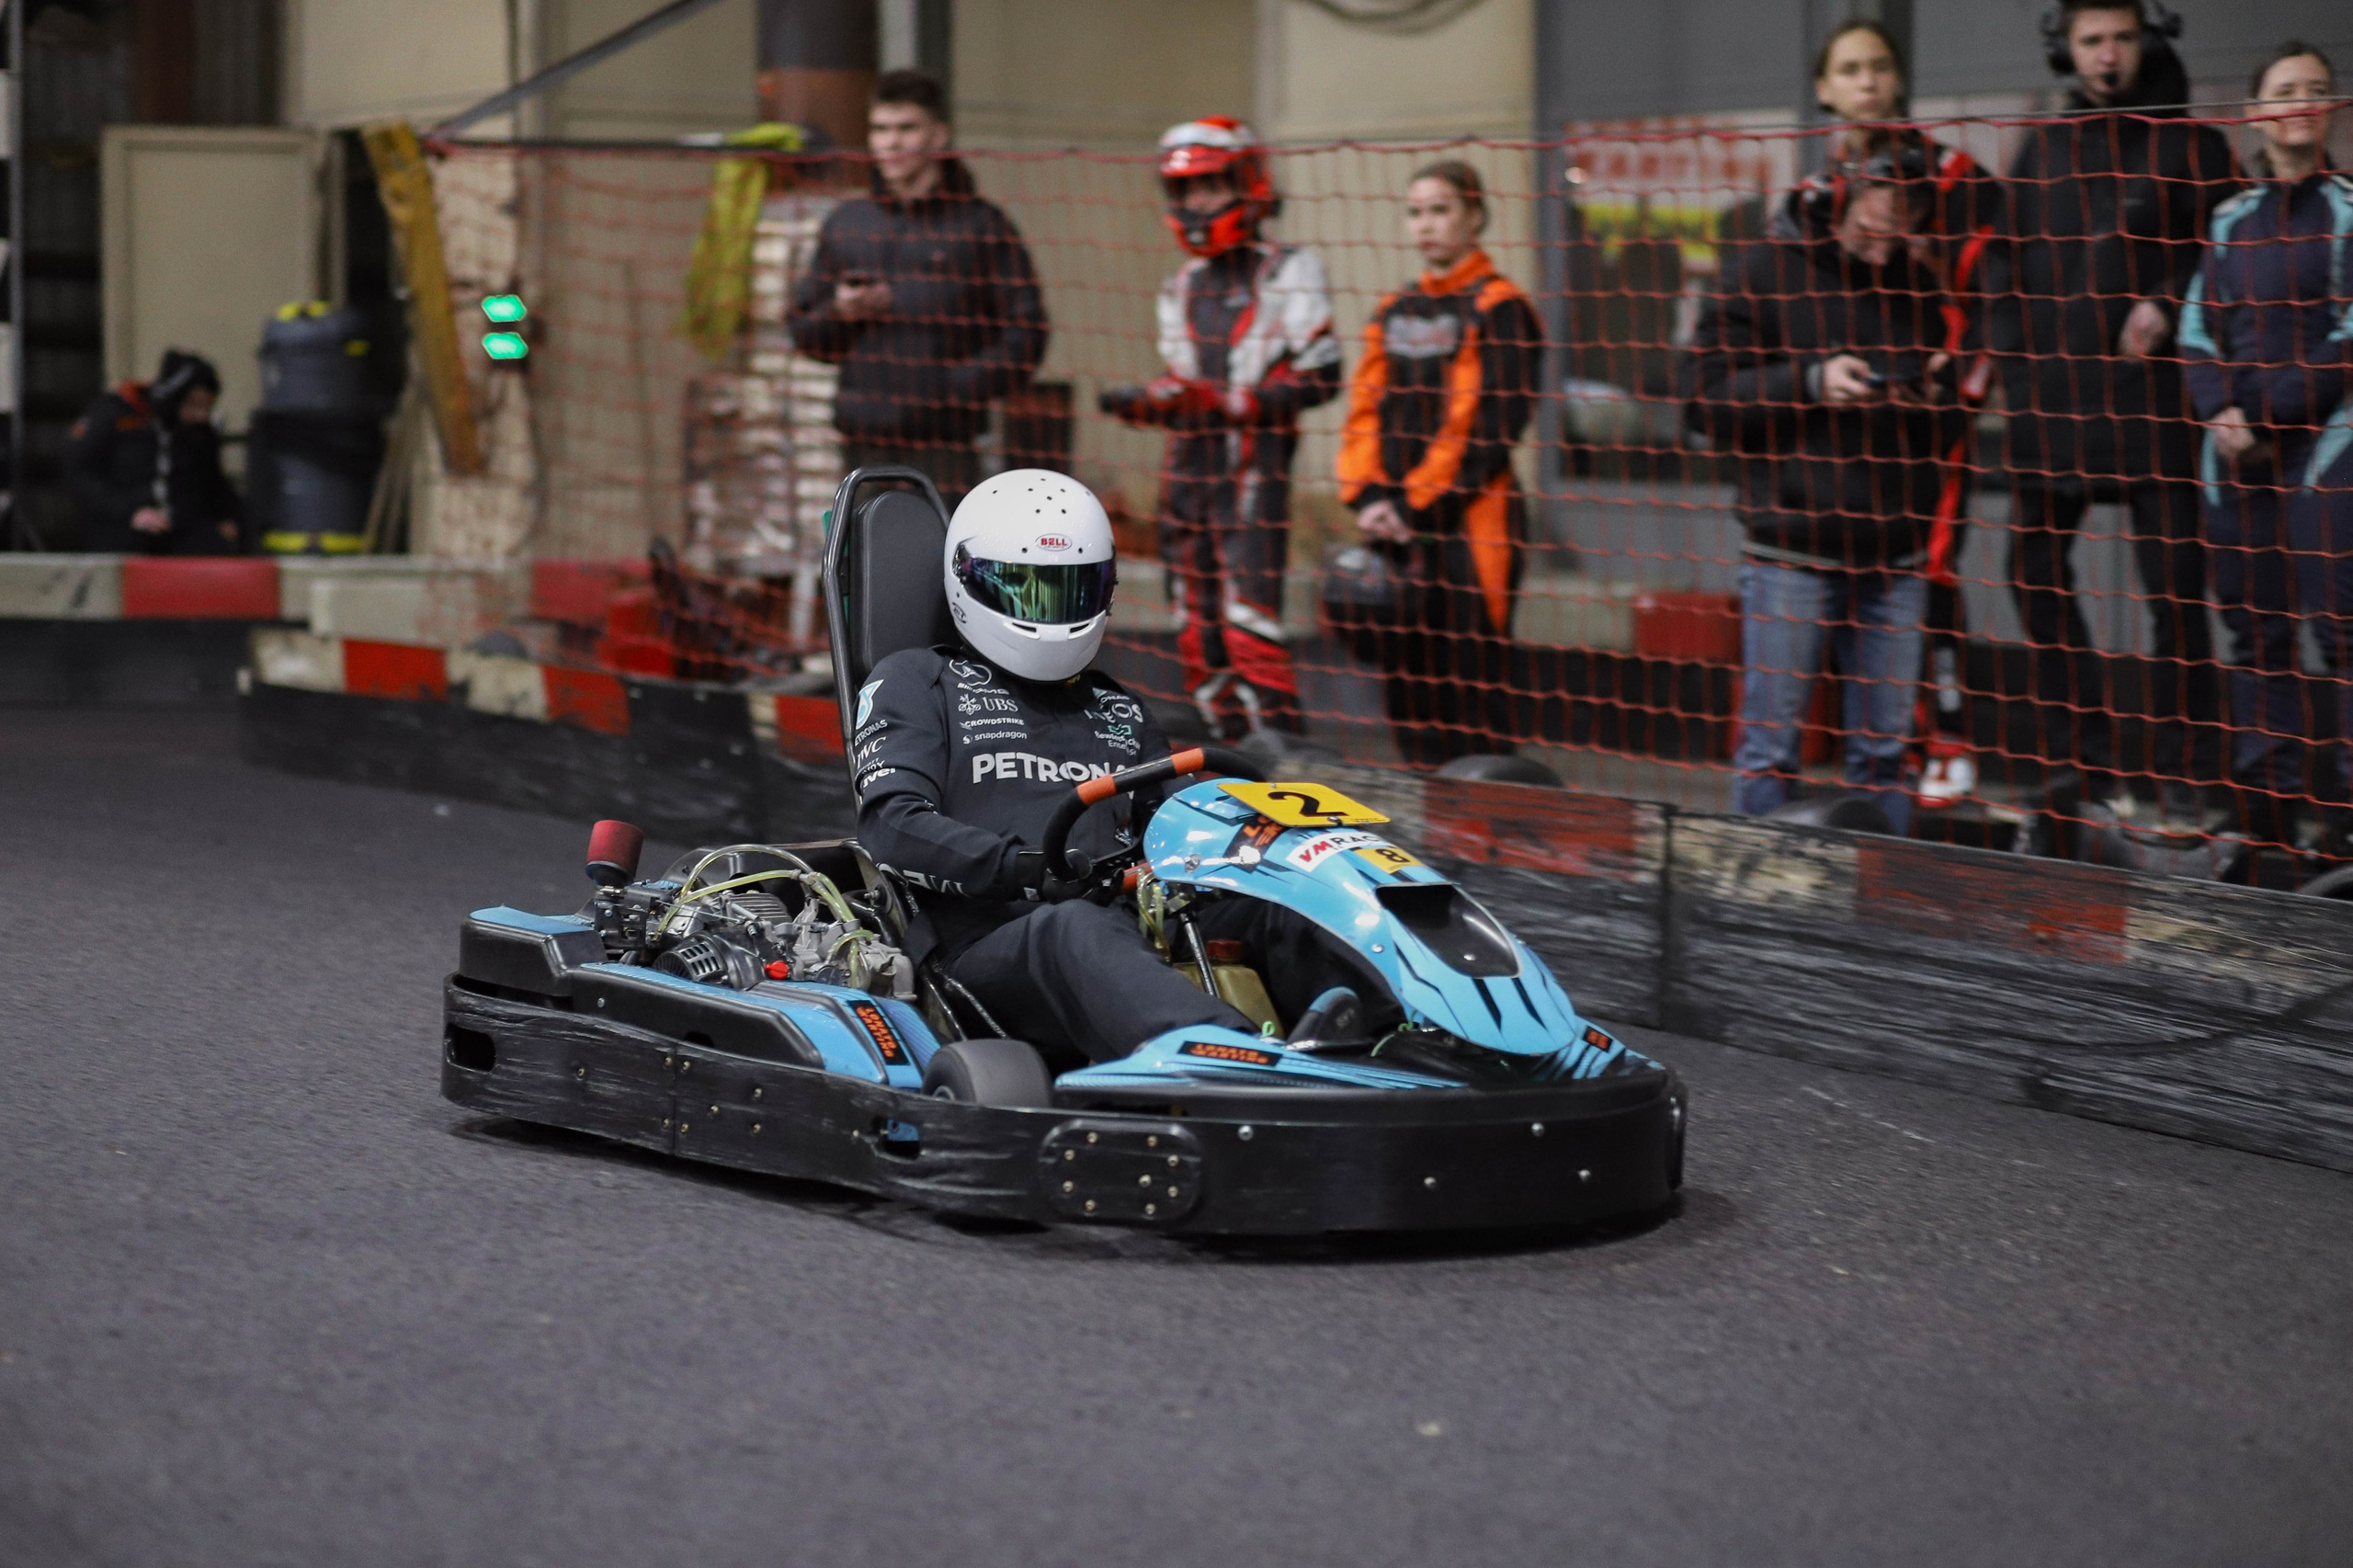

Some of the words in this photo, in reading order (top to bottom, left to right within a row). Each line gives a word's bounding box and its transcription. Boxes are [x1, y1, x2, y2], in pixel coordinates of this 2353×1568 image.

[1040, 538, 1067, 546] BELL
[983, 697, 1018, 711] UBS
[964, 718, 1025, 727] CROWDSTRIKE
[855, 719, 888, 746] ETRONAS
[974, 731, 1028, 741] snapdragon
[1267, 791, 1350, 817] 2
[1375, 849, 1410, 862] 8
